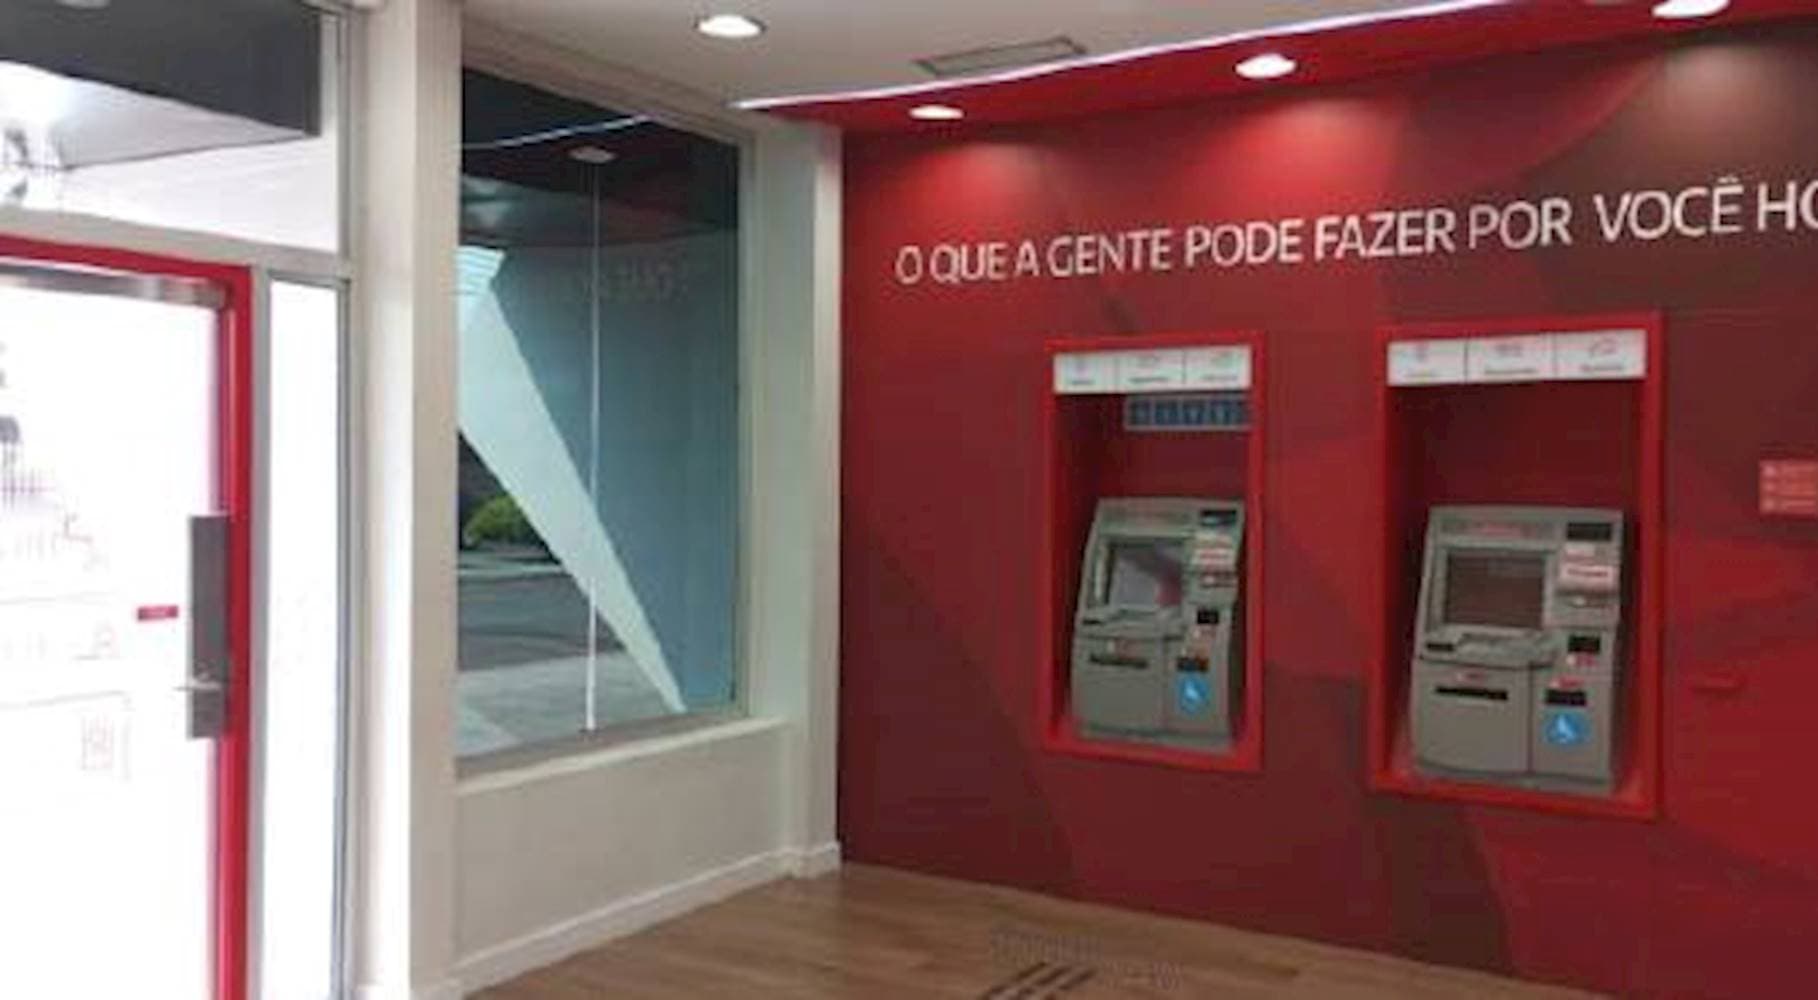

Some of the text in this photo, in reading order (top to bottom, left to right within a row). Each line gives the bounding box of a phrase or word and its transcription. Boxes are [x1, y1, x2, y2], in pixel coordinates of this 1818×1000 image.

[895, 244, 923, 284] O
[929, 241, 1007, 284] QUE
[1014, 239, 1040, 276] A
[1046, 229, 1174, 277] GENTE
[1183, 219, 1305, 266] PODE
[1314, 207, 1457, 261] FAZER
[1467, 198, 1574, 250] POR
[1594, 176, 1746, 242] VOCÊ
